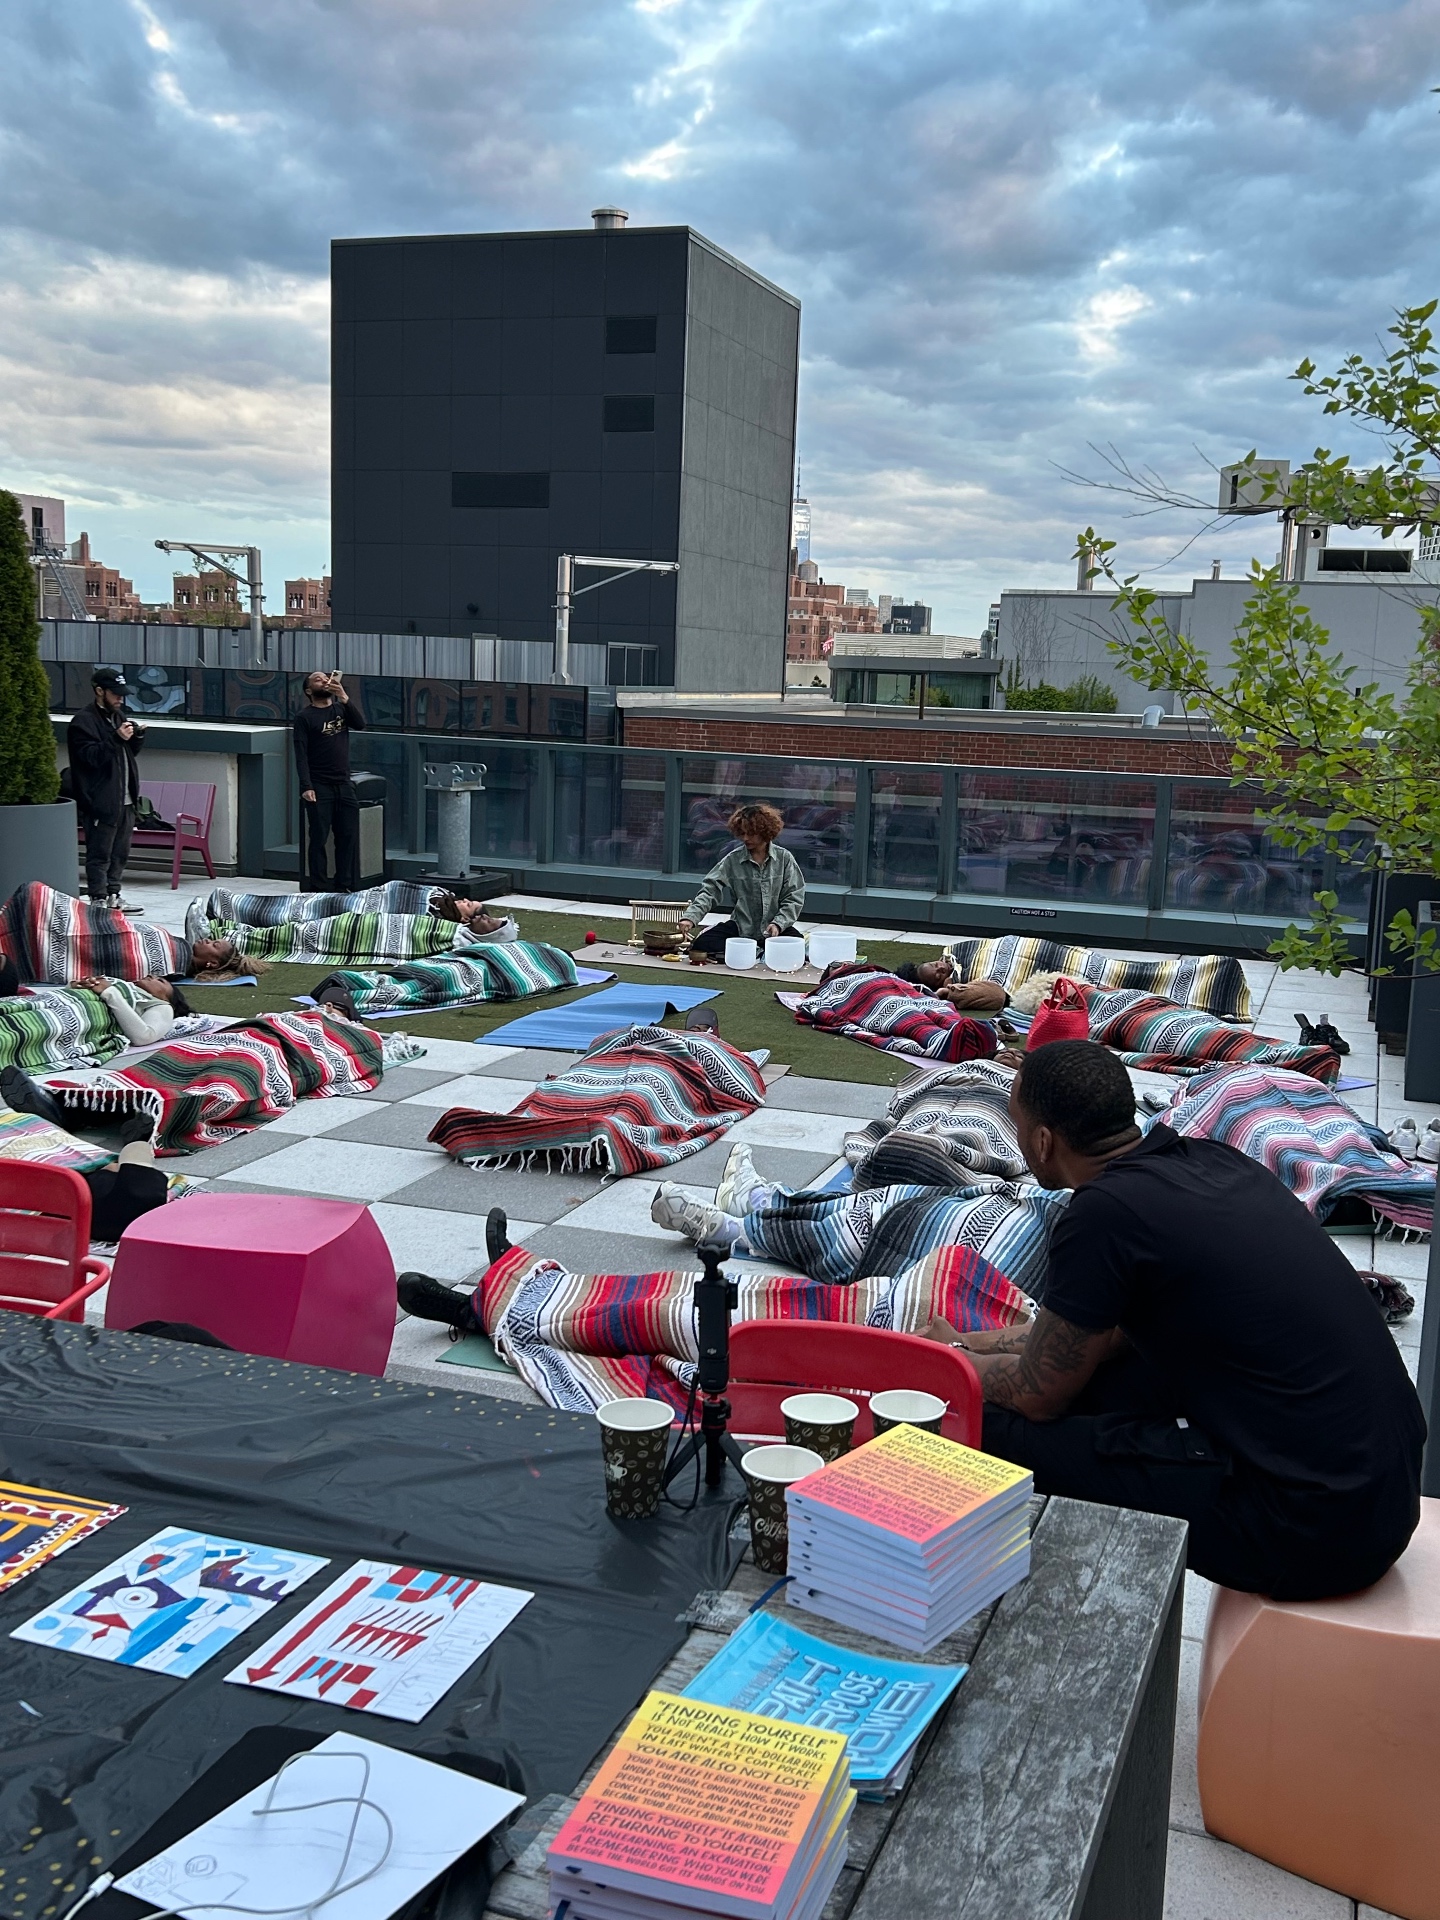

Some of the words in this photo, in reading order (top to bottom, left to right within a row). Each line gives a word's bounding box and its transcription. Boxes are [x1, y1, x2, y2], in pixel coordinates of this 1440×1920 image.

[752, 1654, 841, 1720] PATH
[802, 1670, 888, 1735] RPOSE
[646, 1722, 672, 1735] YOU
[671, 1729, 720, 1746] AREN'T
[720, 1740, 730, 1749] A
[733, 1743, 801, 1766] TEN-DOLLAR
[801, 1759, 823, 1771] BILL
[650, 1711, 664, 1721] IS
[665, 1714, 694, 1728] NOT
[694, 1721, 738, 1738] REALLY
[739, 1731, 771, 1745] HOW
[773, 1740, 787, 1750] IT
[787, 1743, 826, 1760] WORKS.
[658, 1700, 740, 1728] "FINDING
[744, 1721, 837, 1748] YOURSELF"
[846, 1680, 935, 1766] POWER
[635, 1742, 668, 1756] YOU
[668, 1750, 701, 1764] ARE
[699, 1757, 736, 1773] ALSO
[738, 1766, 772, 1780] NOT
[773, 1773, 812, 1790] LOST.
[641, 1731, 658, 1742] IN
[659, 1736, 687, 1748] LAST
[688, 1742, 741, 1761] WINTER'S
[744, 1755, 775, 1768] COAT
[614, 1771, 656, 1787] PEOPLE'S
[705, 1792, 729, 1803] AND
[729, 1797, 795, 1818] INACCURATE
[621, 1762, 655, 1776] UNDER
[655, 1770, 699, 1787] CULTURAL
[700, 1781, 767, 1804] CONDITIONING,
[769, 1797, 800, 1809] OTHER
[626, 1753, 653, 1765] YOUR
[654, 1759, 678, 1771] TRUE
[678, 1765, 702, 1777] SELF
[702, 1770, 713, 1780] IS
[712, 1773, 742, 1786] RIGHT
[773, 1787, 806, 1800] BURIED
[593, 1798, 656, 1821] "FINDING
[721, 1828, 736, 1840] IS
[733, 1832, 785, 1850] ACTUALLY
[601, 1787, 640, 1803] BECAME
[641, 1797, 665, 1808] YOUR
[664, 1802, 701, 1817] BELIEFS
[700, 1811, 731, 1824] ABOUT
[731, 1818, 753, 1829] WHO
[753, 1822, 771, 1833] YOU
[608, 1779, 673, 1800] CONCLUSIONS
[674, 1794, 696, 1805] YOU
[696, 1800, 725, 1812] DREW
[726, 1806, 738, 1815] AS
[737, 1809, 748, 1817] A
[747, 1811, 766, 1822] KID
[768, 1816, 794, 1827] THAT
[571, 1833, 582, 1842] A
[584, 1835, 681, 1865] REMEMBERING
[683, 1857, 713, 1872] WHO
[713, 1864, 738, 1877] YOU
[738, 1870, 769, 1885] WERE
[577, 1821, 596, 1834] AN
[597, 1828, 676, 1853] UNLEARNING,
[678, 1845, 699, 1857] AN
[585, 1810, 680, 1840] RETURNING
[683, 1832, 700, 1844] TO
[702, 1836, 780, 1863] YOURSELF.
[565, 1842, 604, 1857] BEFORE
[606, 1851, 624, 1862] THE
[624, 1855, 657, 1869] WORLD
[657, 1863, 677, 1874] GOT
[677, 1867, 694, 1878] ITS
[693, 1871, 727, 1886] HANDS
[728, 1879, 744, 1889] ON
